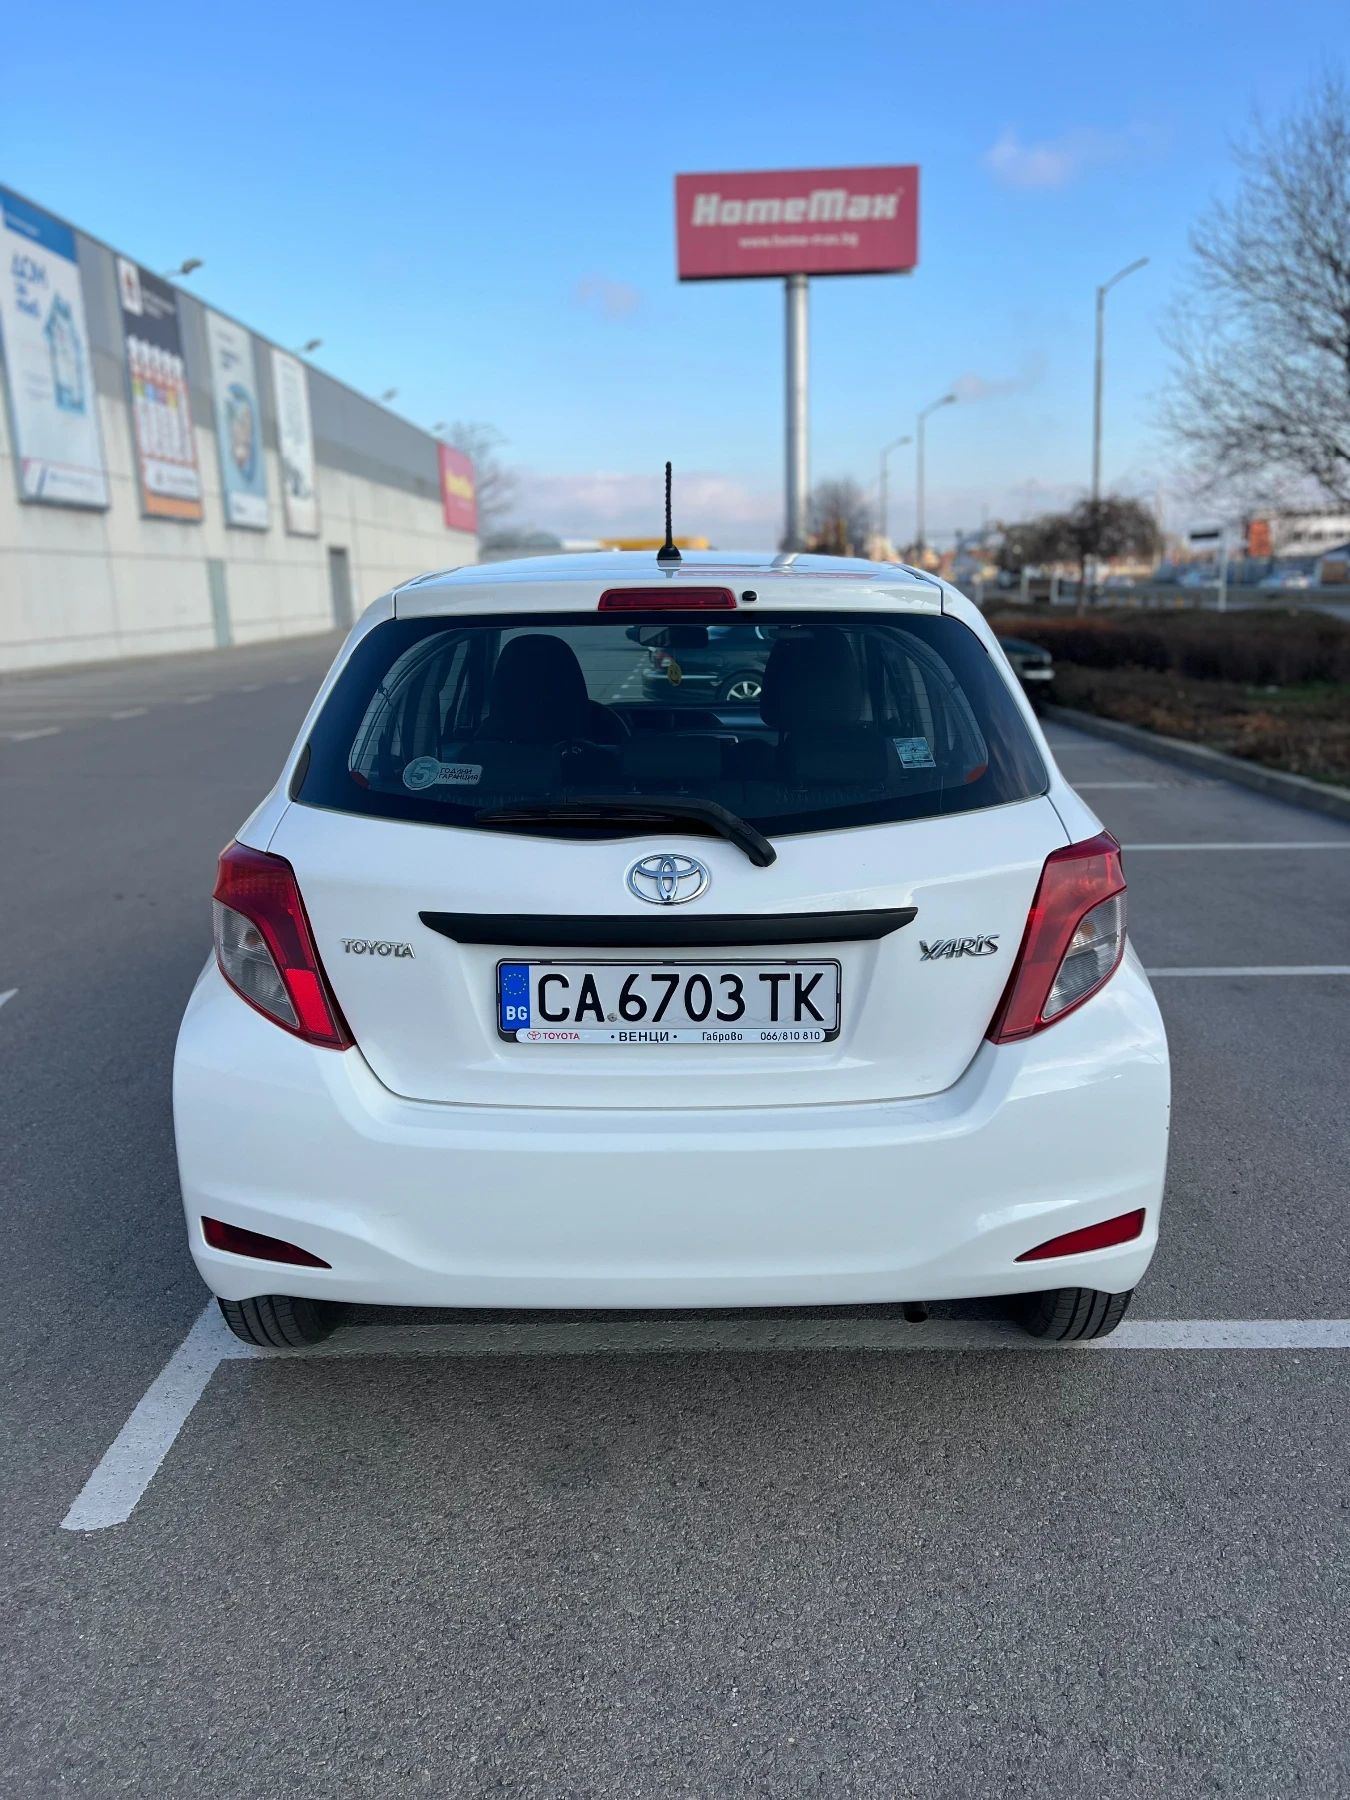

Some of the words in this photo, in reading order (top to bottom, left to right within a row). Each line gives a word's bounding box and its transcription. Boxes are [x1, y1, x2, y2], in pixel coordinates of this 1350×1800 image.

[692, 189, 899, 226] HomeMax
[411, 762, 432, 783] 5
[340, 938, 416, 959] TOYOTA
[618, 973, 746, 1023] 6703
[506, 1006, 528, 1021] BG
[543, 1032, 580, 1040] TOYOTA
[618, 1031, 669, 1044] ВЕНЦИ
[760, 1031, 800, 1041] 066/810
[802, 1031, 820, 1040] 810
